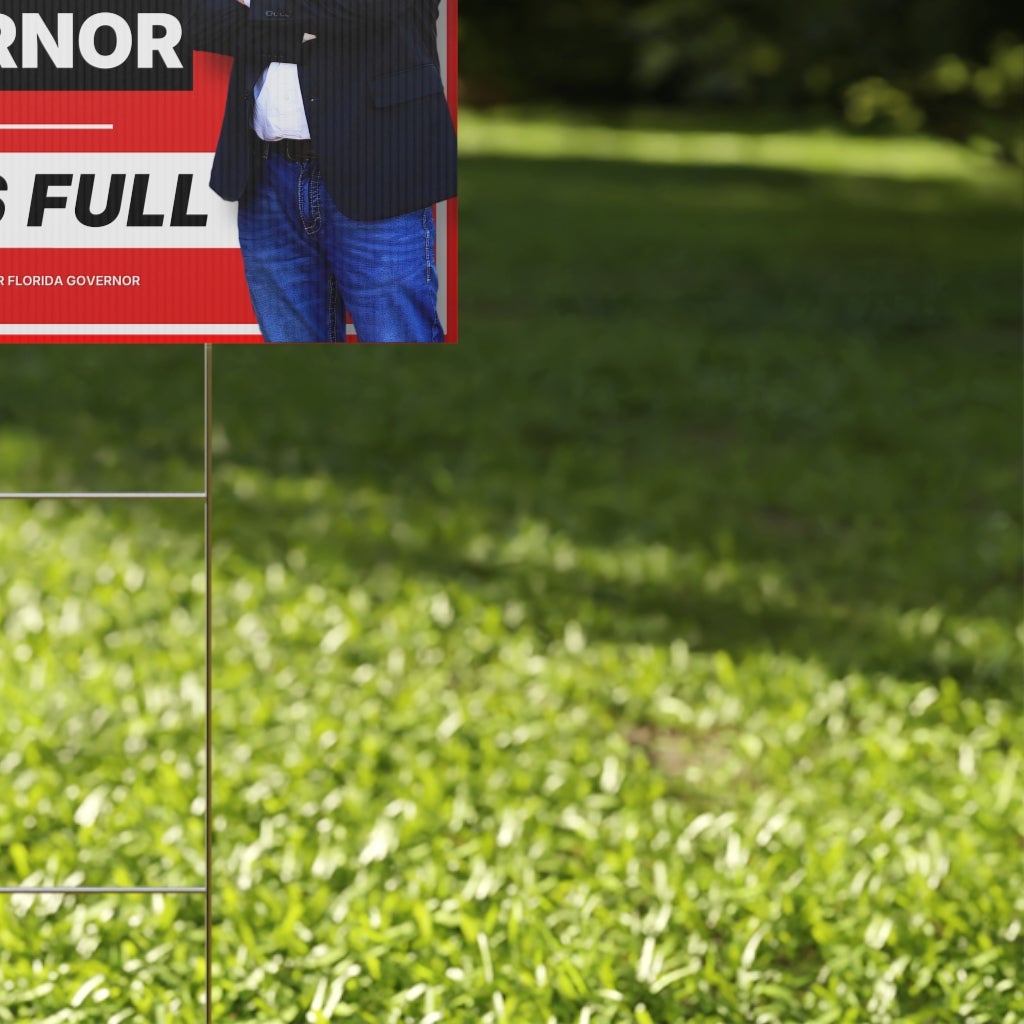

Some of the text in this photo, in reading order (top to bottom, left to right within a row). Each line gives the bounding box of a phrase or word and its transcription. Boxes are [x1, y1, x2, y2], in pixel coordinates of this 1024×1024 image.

[27, 174, 209, 227] FULL
[7, 275, 64, 286] FLORIDA
[66, 275, 141, 286] GOVERNOR
